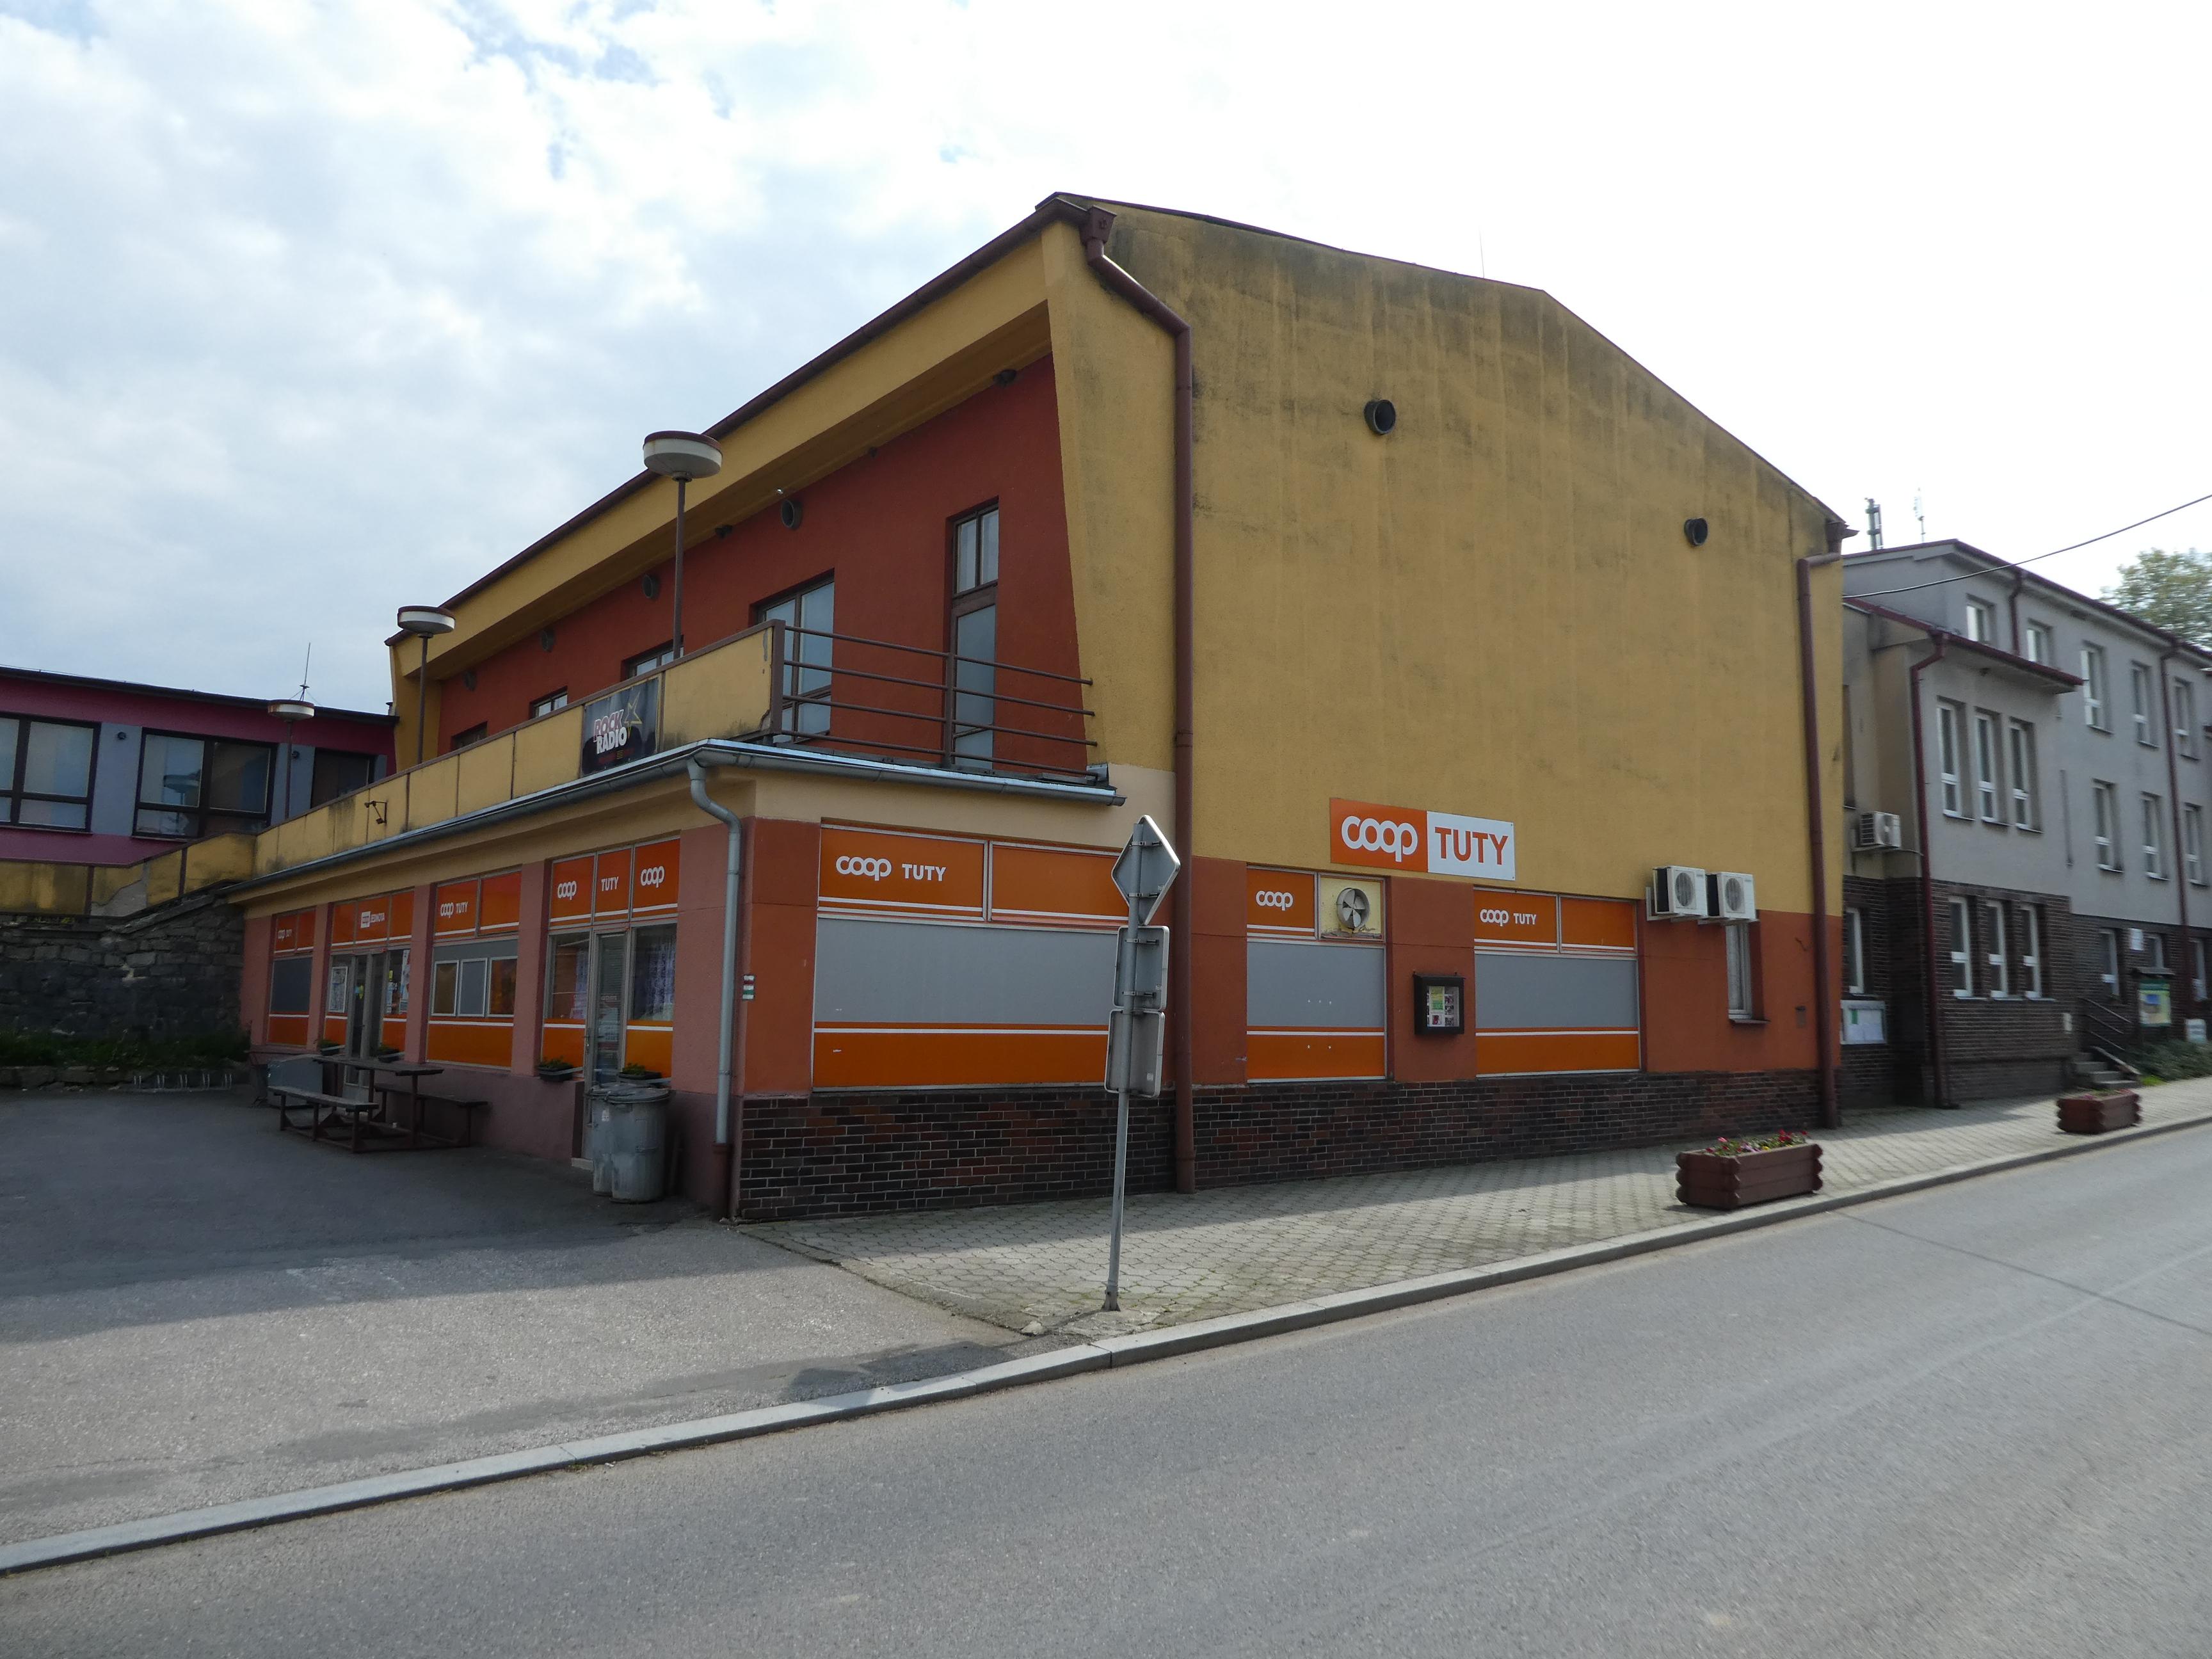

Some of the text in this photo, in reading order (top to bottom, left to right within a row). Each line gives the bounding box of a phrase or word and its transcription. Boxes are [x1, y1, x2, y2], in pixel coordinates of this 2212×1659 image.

[593, 709, 625, 742] ROCK
[597, 726, 627, 754] RADIO
[1434, 826, 1509, 865] TUTY
[901, 863, 947, 881] TUTY
[600, 876, 619, 892] TUTY
[456, 901, 469, 913] TUTY
[1513, 913, 1537, 925] TUTY
